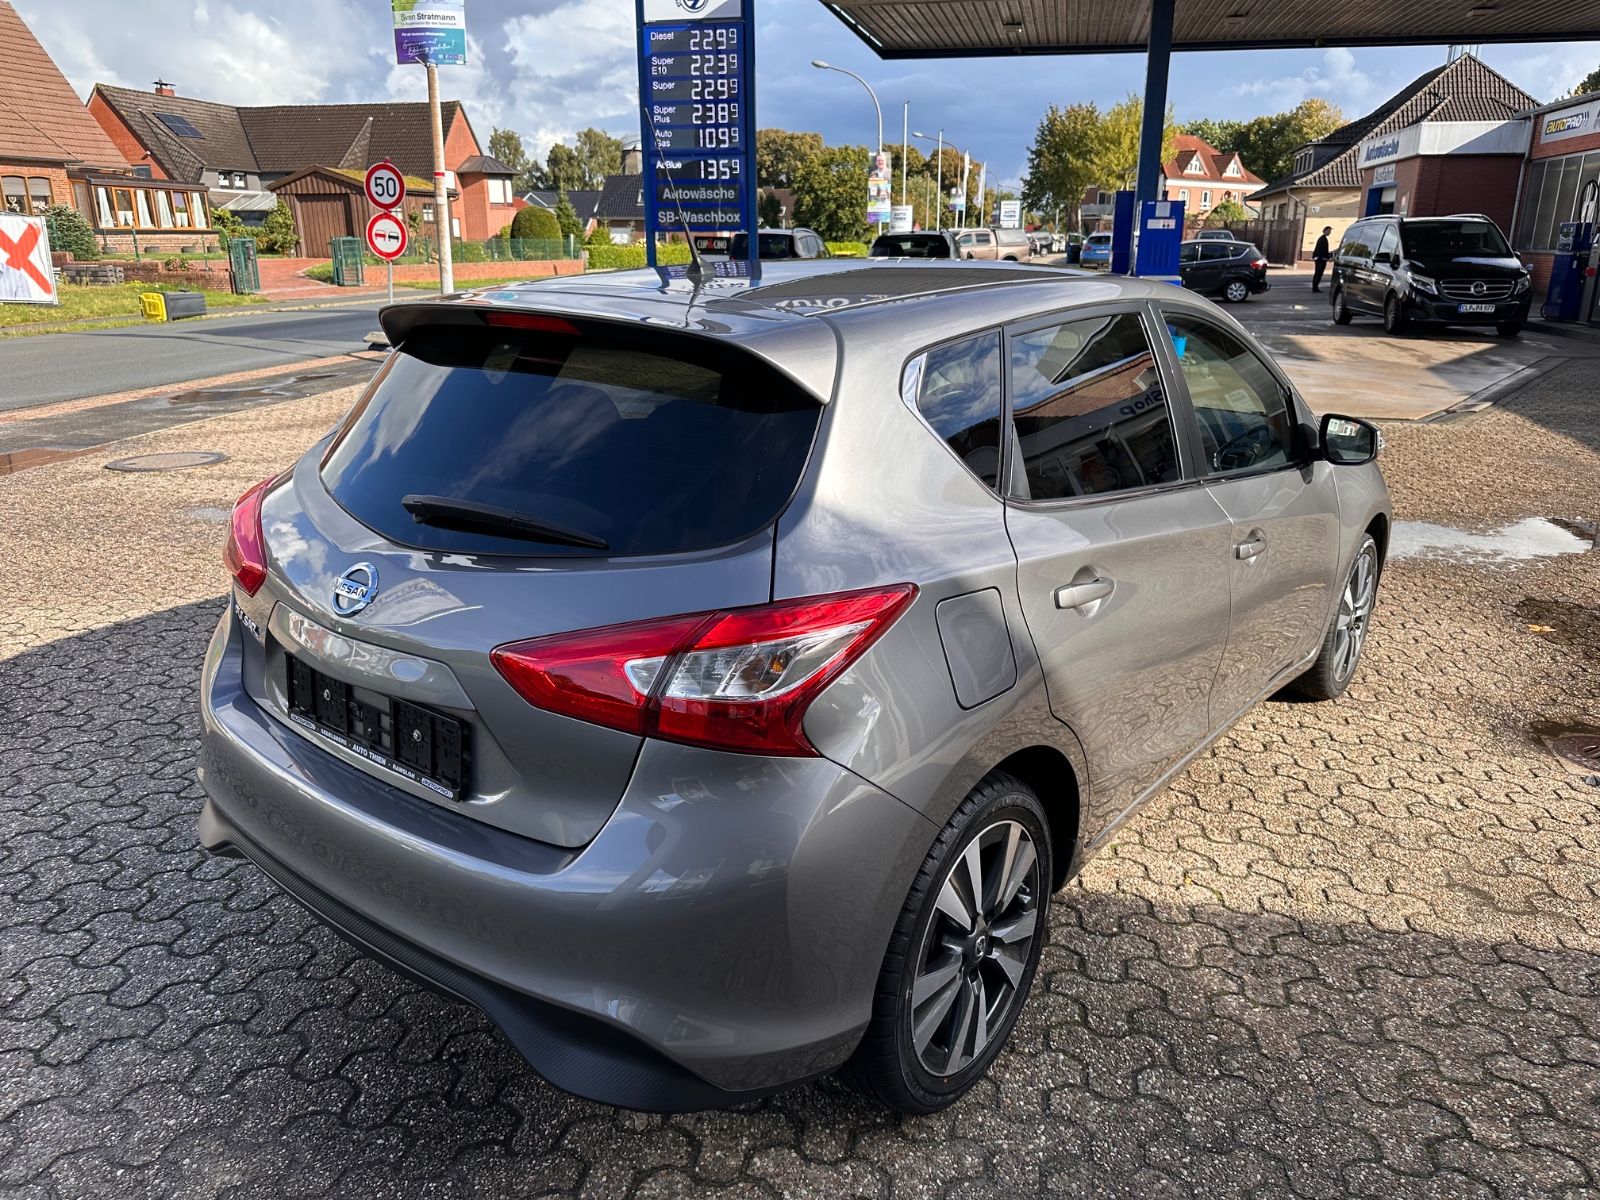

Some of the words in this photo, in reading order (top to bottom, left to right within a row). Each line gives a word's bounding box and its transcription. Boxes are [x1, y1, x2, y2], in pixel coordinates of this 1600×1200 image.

[401, 13, 416, 21] Sven
[416, 13, 456, 21] Stratmann
[650, 32, 674, 40] Diesel
[651, 57, 674, 66] Super
[651, 67, 667, 75] E10
[652, 81, 675, 91] Super
[653, 105, 676, 115] Super
[654, 115, 671, 123] Plus
[655, 129, 673, 138] Auto
[655, 139, 671, 147] Gas
[374, 176, 397, 198] 50
[663, 187, 735, 200] Autowäsche
[658, 211, 741, 223] SB-Waschbox
[334, 576, 369, 599] NISSAN
[352, 743, 368, 756] AUTO
[369, 751, 386, 765] THIEN
